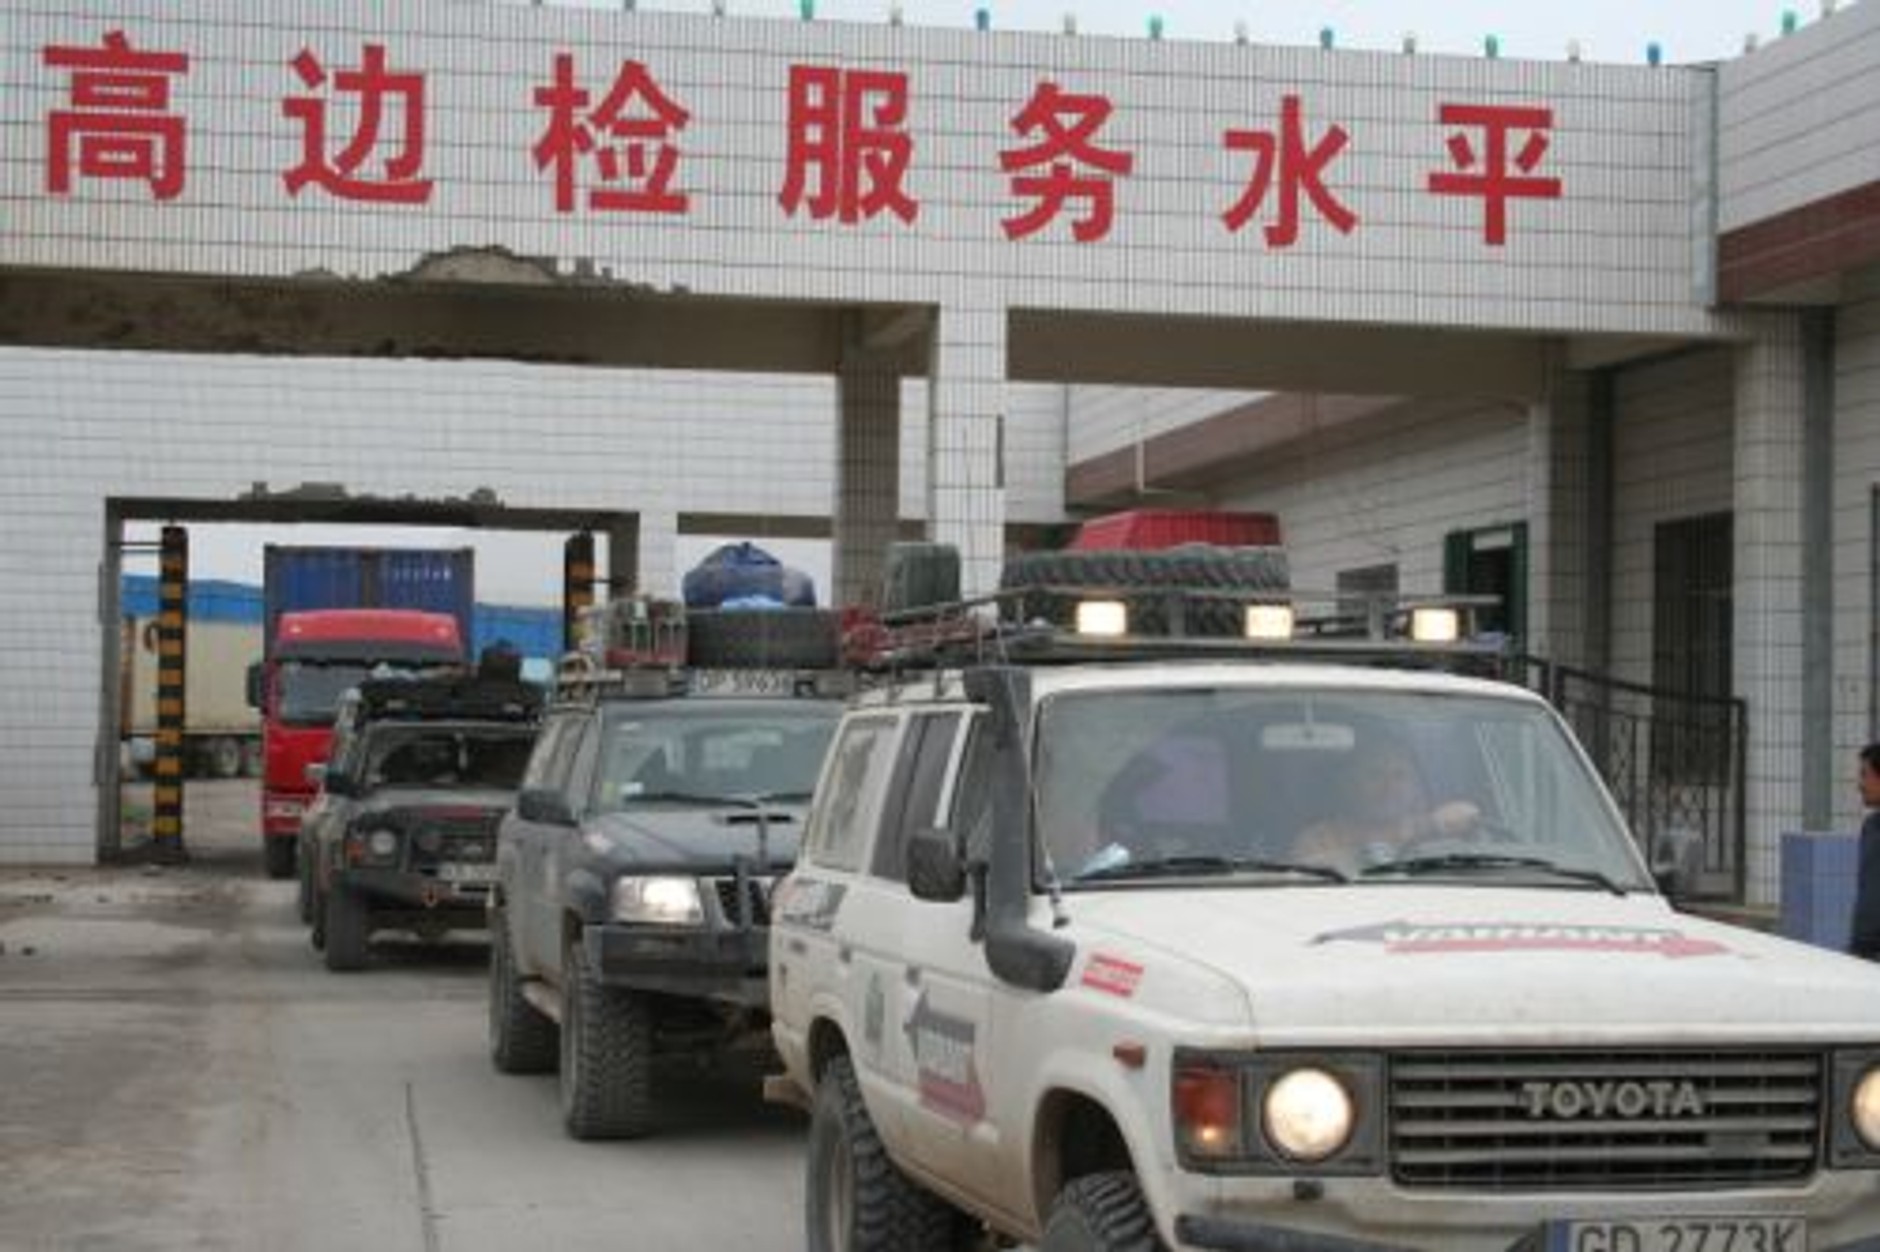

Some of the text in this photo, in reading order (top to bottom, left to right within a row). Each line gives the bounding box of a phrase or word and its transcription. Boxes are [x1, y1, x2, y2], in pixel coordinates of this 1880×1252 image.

[43, 31, 1563, 247] 高边检服务水平
[1522, 1081, 1702, 1117] TOYOTA
[1577, 1221, 1801, 1252] GD 2773K
